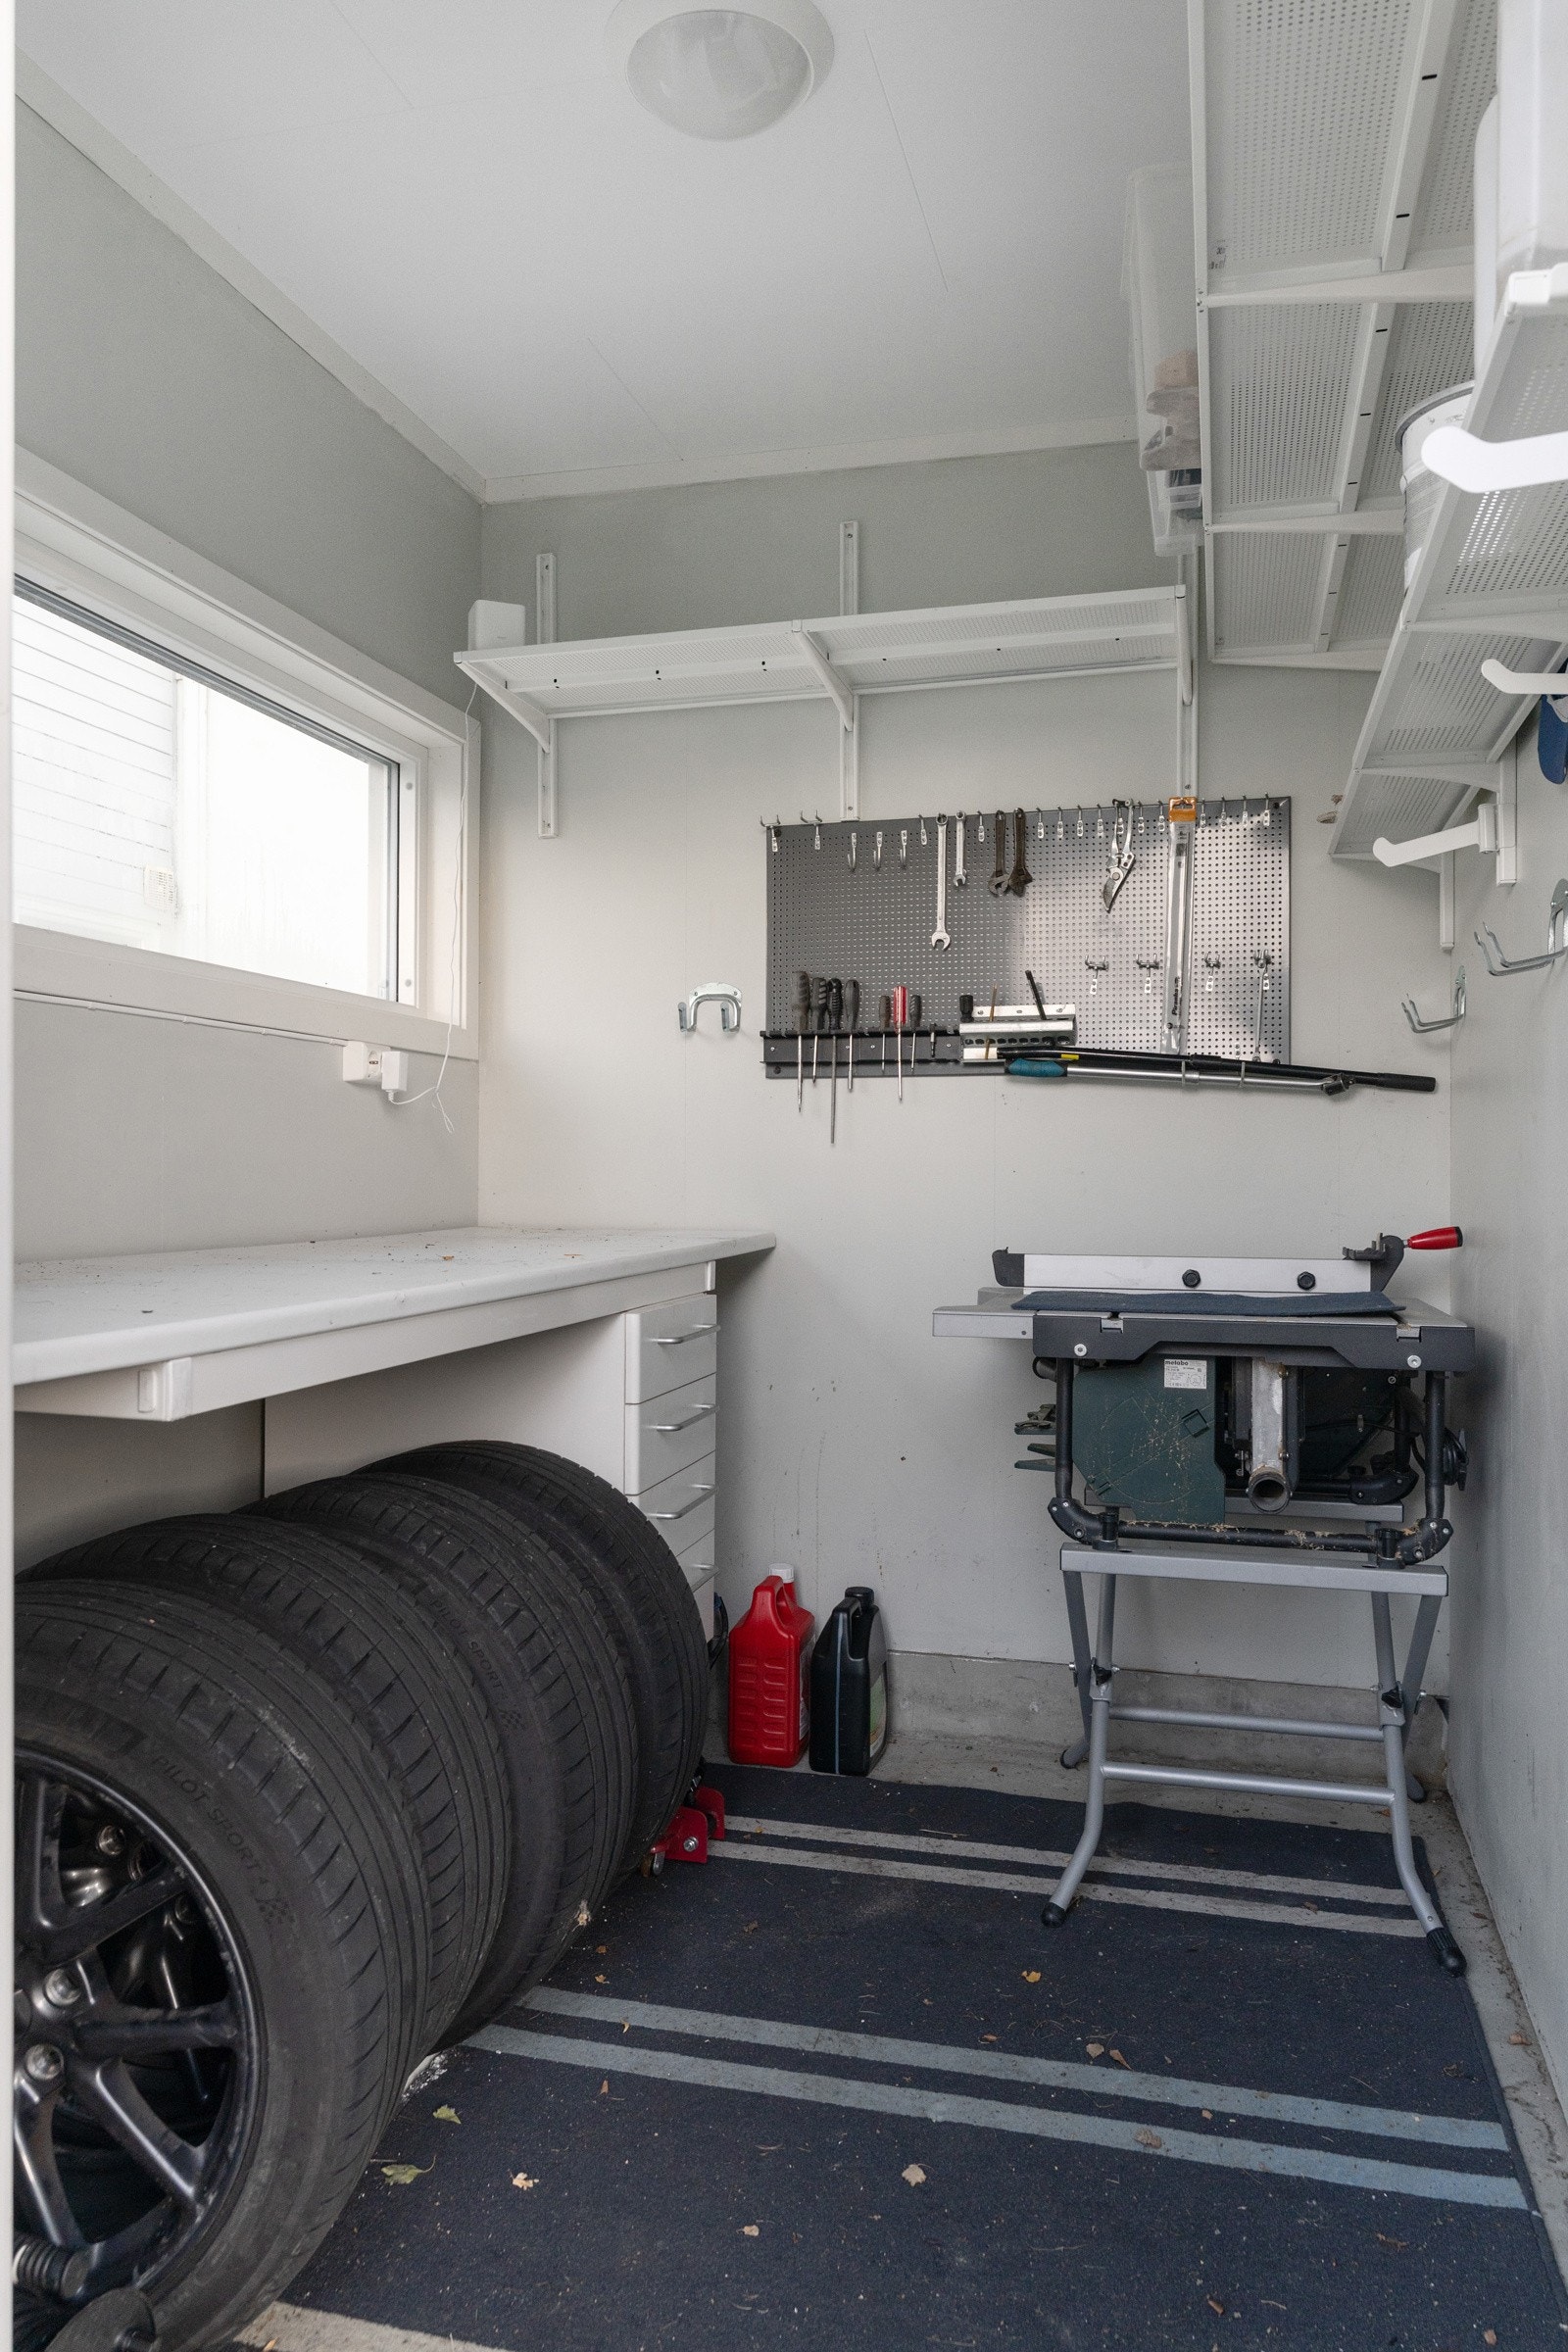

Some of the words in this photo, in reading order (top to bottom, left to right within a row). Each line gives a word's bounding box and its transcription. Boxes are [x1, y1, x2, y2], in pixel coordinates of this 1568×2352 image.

[429, 1599, 469, 1637] PILOT
[468, 1641, 505, 1690] SPORT
[152, 1755, 210, 1803] PILOT
[205, 1808, 261, 1871] SPORT
